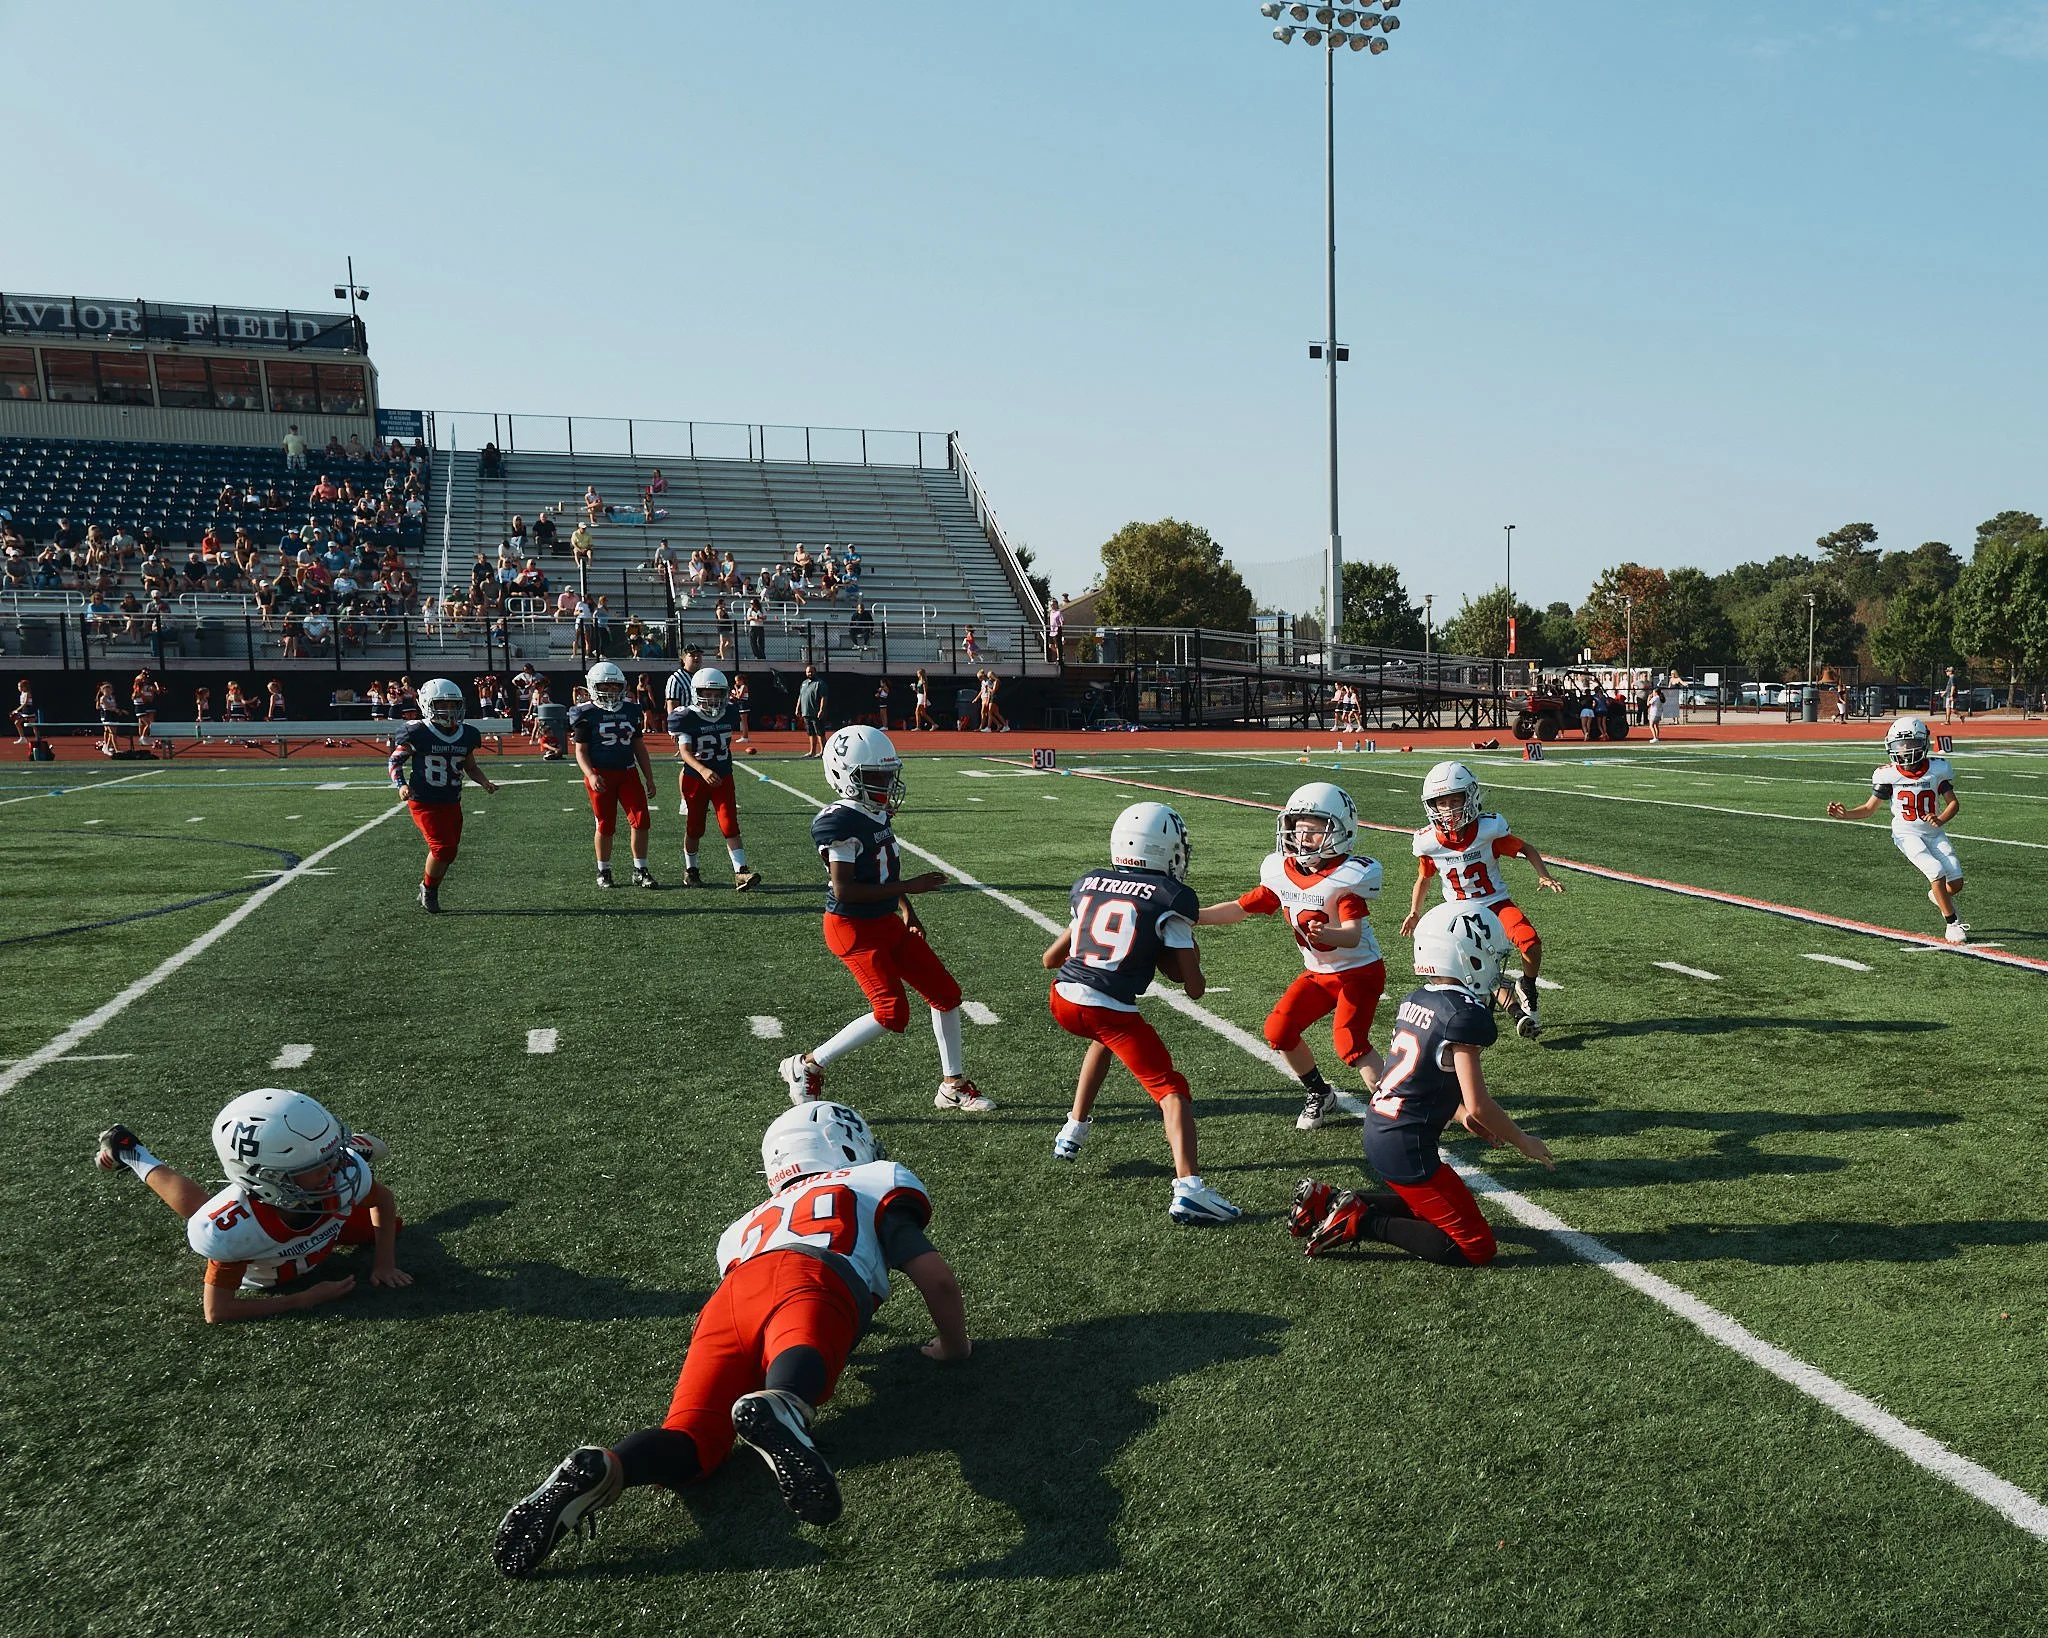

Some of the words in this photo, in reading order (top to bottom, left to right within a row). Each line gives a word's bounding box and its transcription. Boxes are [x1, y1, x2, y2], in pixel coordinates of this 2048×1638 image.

[182, 311, 320, 341] FIELD
[599, 721, 635, 746] 53
[695, 732, 732, 762] 65
[1938, 736, 1953, 753] 10
[1034, 749, 1055, 768] 30
[1527, 743, 1543, 760] 20
[424, 755, 466, 787] 85
[1897, 789, 1936, 822] 30
[876, 842, 900, 885] 1
[1115, 856, 1146, 867] Riddell
[1079, 876, 1156, 900] PATRIOTS
[1446, 860, 1496, 900] 13
[1069, 894, 1139, 972] 19
[768, 1163, 802, 1189] Riddell
[208, 1200, 250, 1231] 15
[726, 1183, 859, 1271] 29
[278, 1238, 309, 1258] MOUNT
